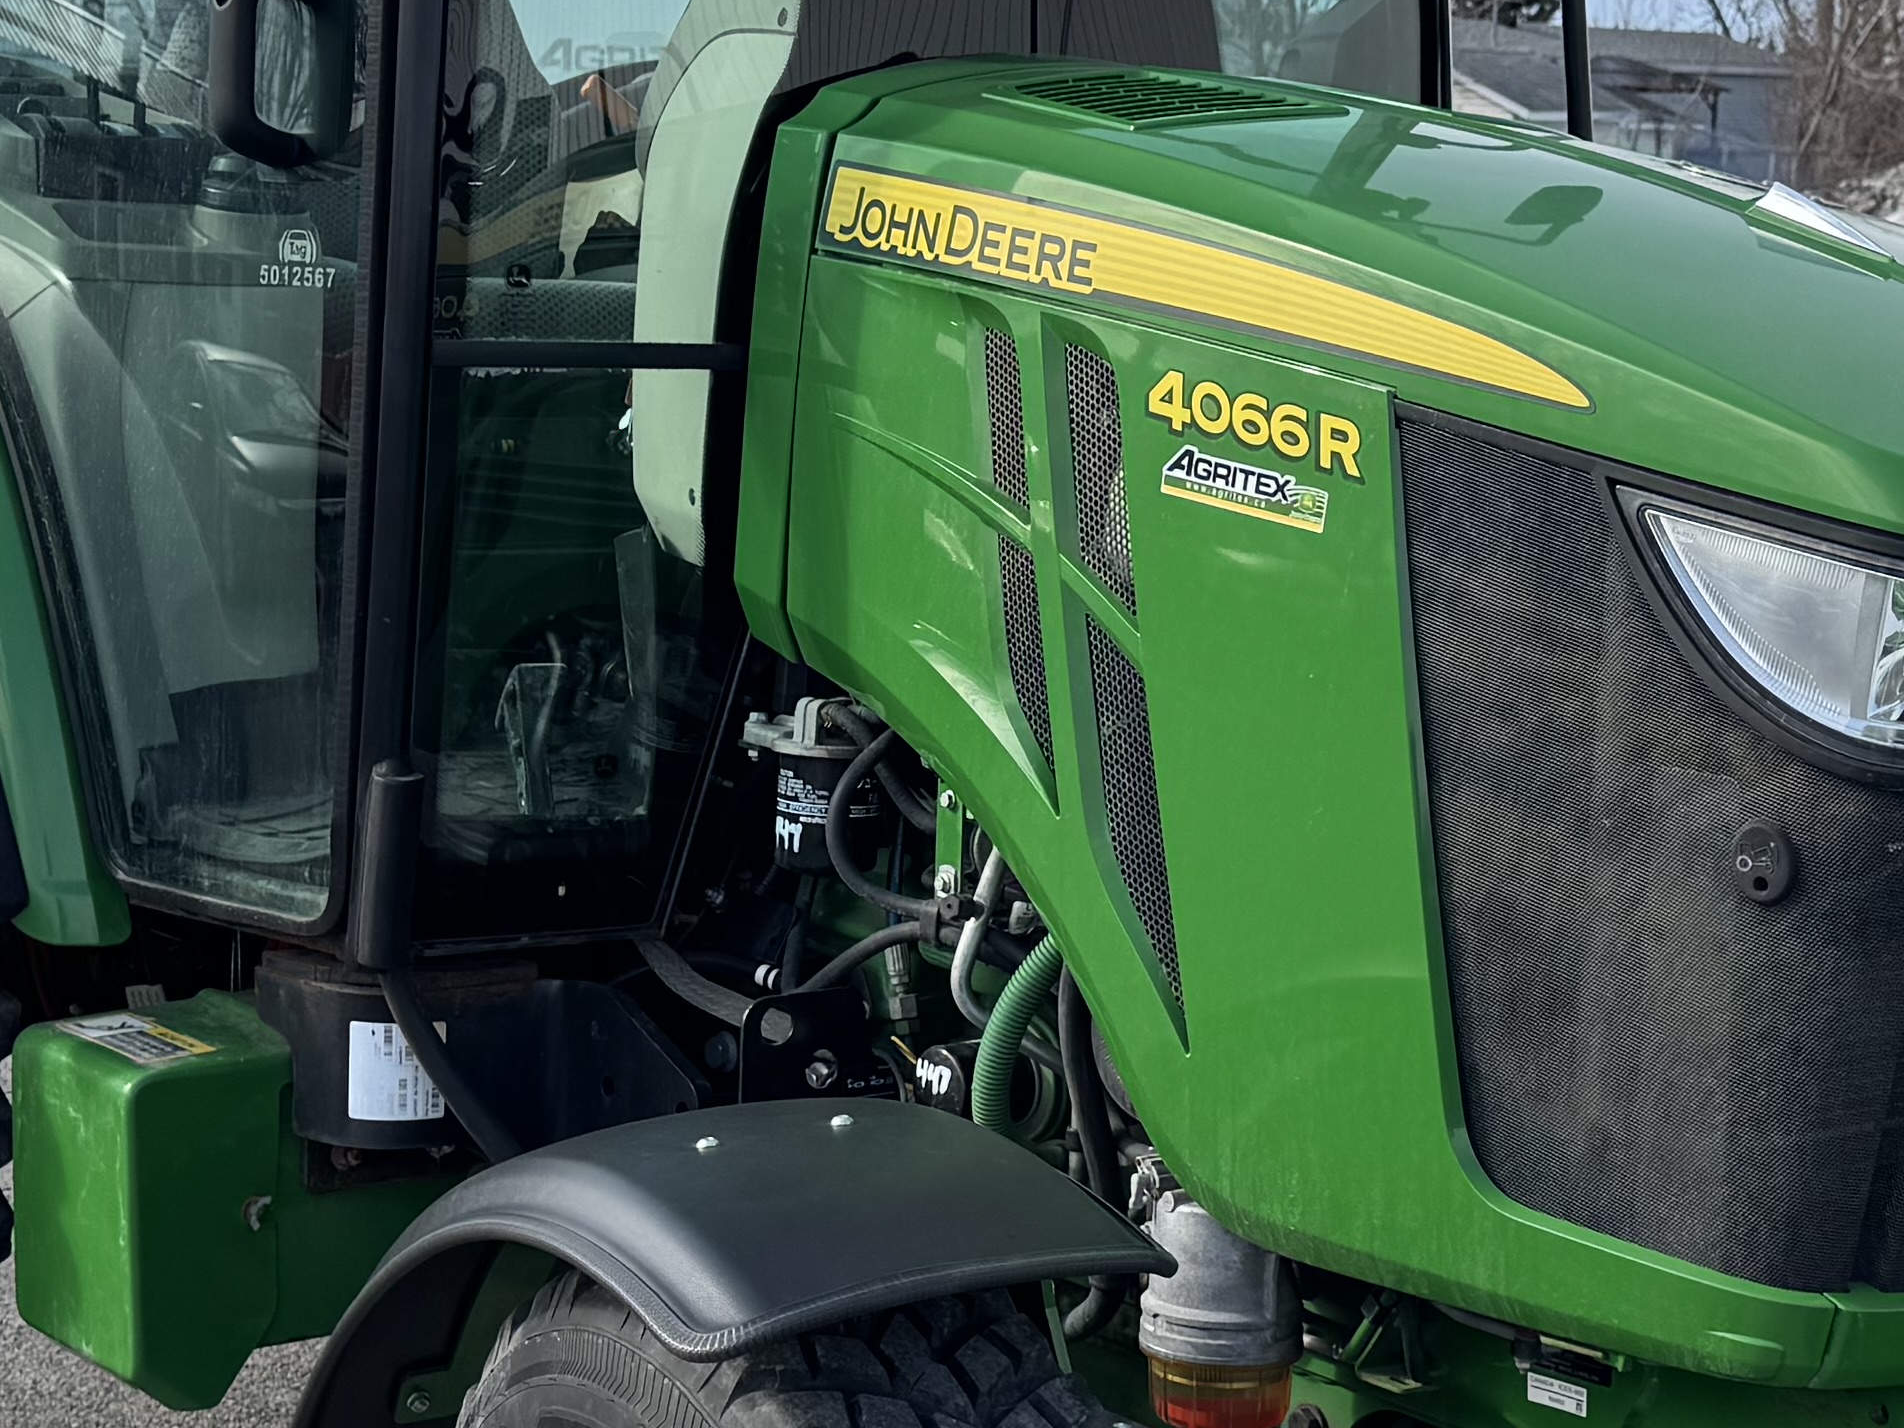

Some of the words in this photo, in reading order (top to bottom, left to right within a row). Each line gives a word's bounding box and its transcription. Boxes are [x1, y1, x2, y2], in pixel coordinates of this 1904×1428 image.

[838, 186, 941, 255] JOHN
[947, 205, 1098, 287] DEERE
[259, 264, 336, 288] 5012567
[1166, 448, 1292, 503] AGRITEX
